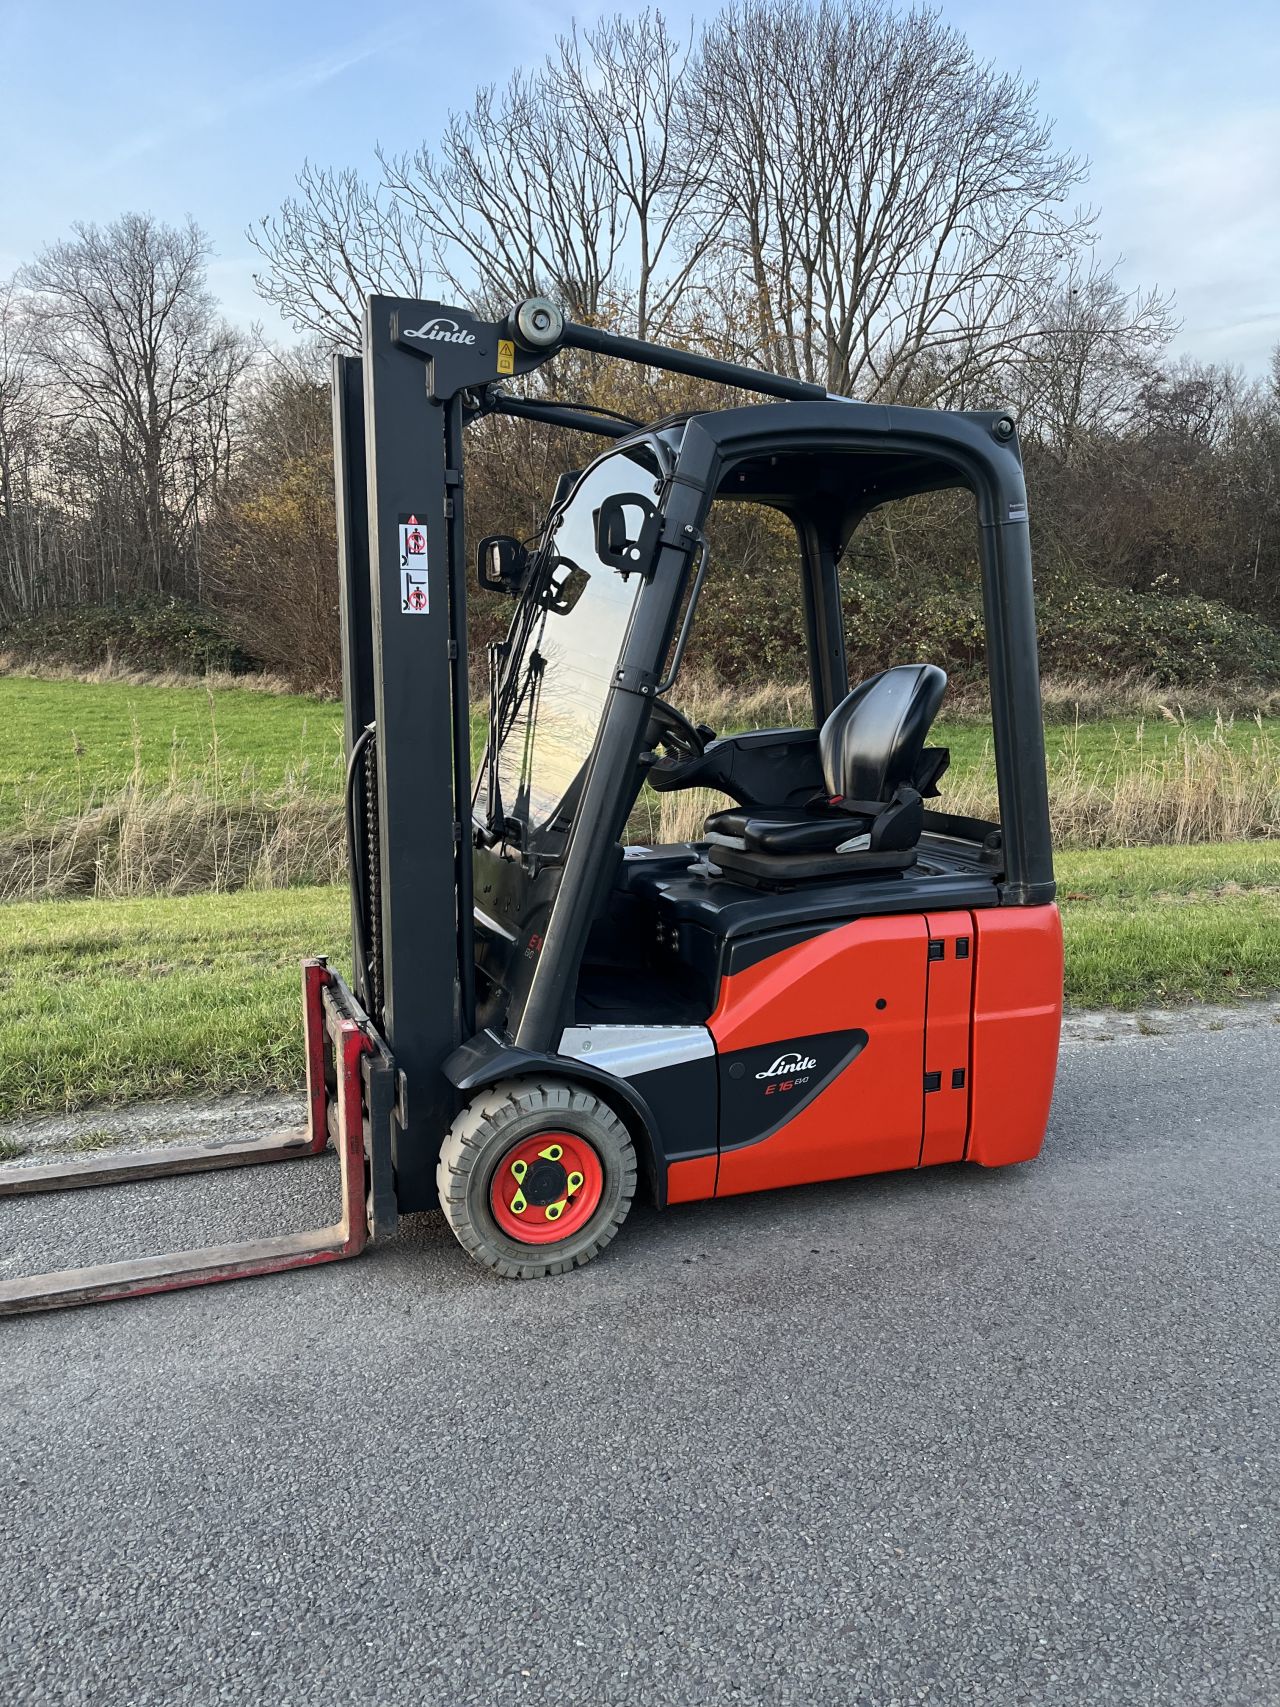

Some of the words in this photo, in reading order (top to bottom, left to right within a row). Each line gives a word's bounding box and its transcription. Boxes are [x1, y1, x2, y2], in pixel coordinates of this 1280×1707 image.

[403, 318, 476, 345] Linde
[755, 1052, 817, 1079] Linde
[765, 1083, 777, 1096] E
